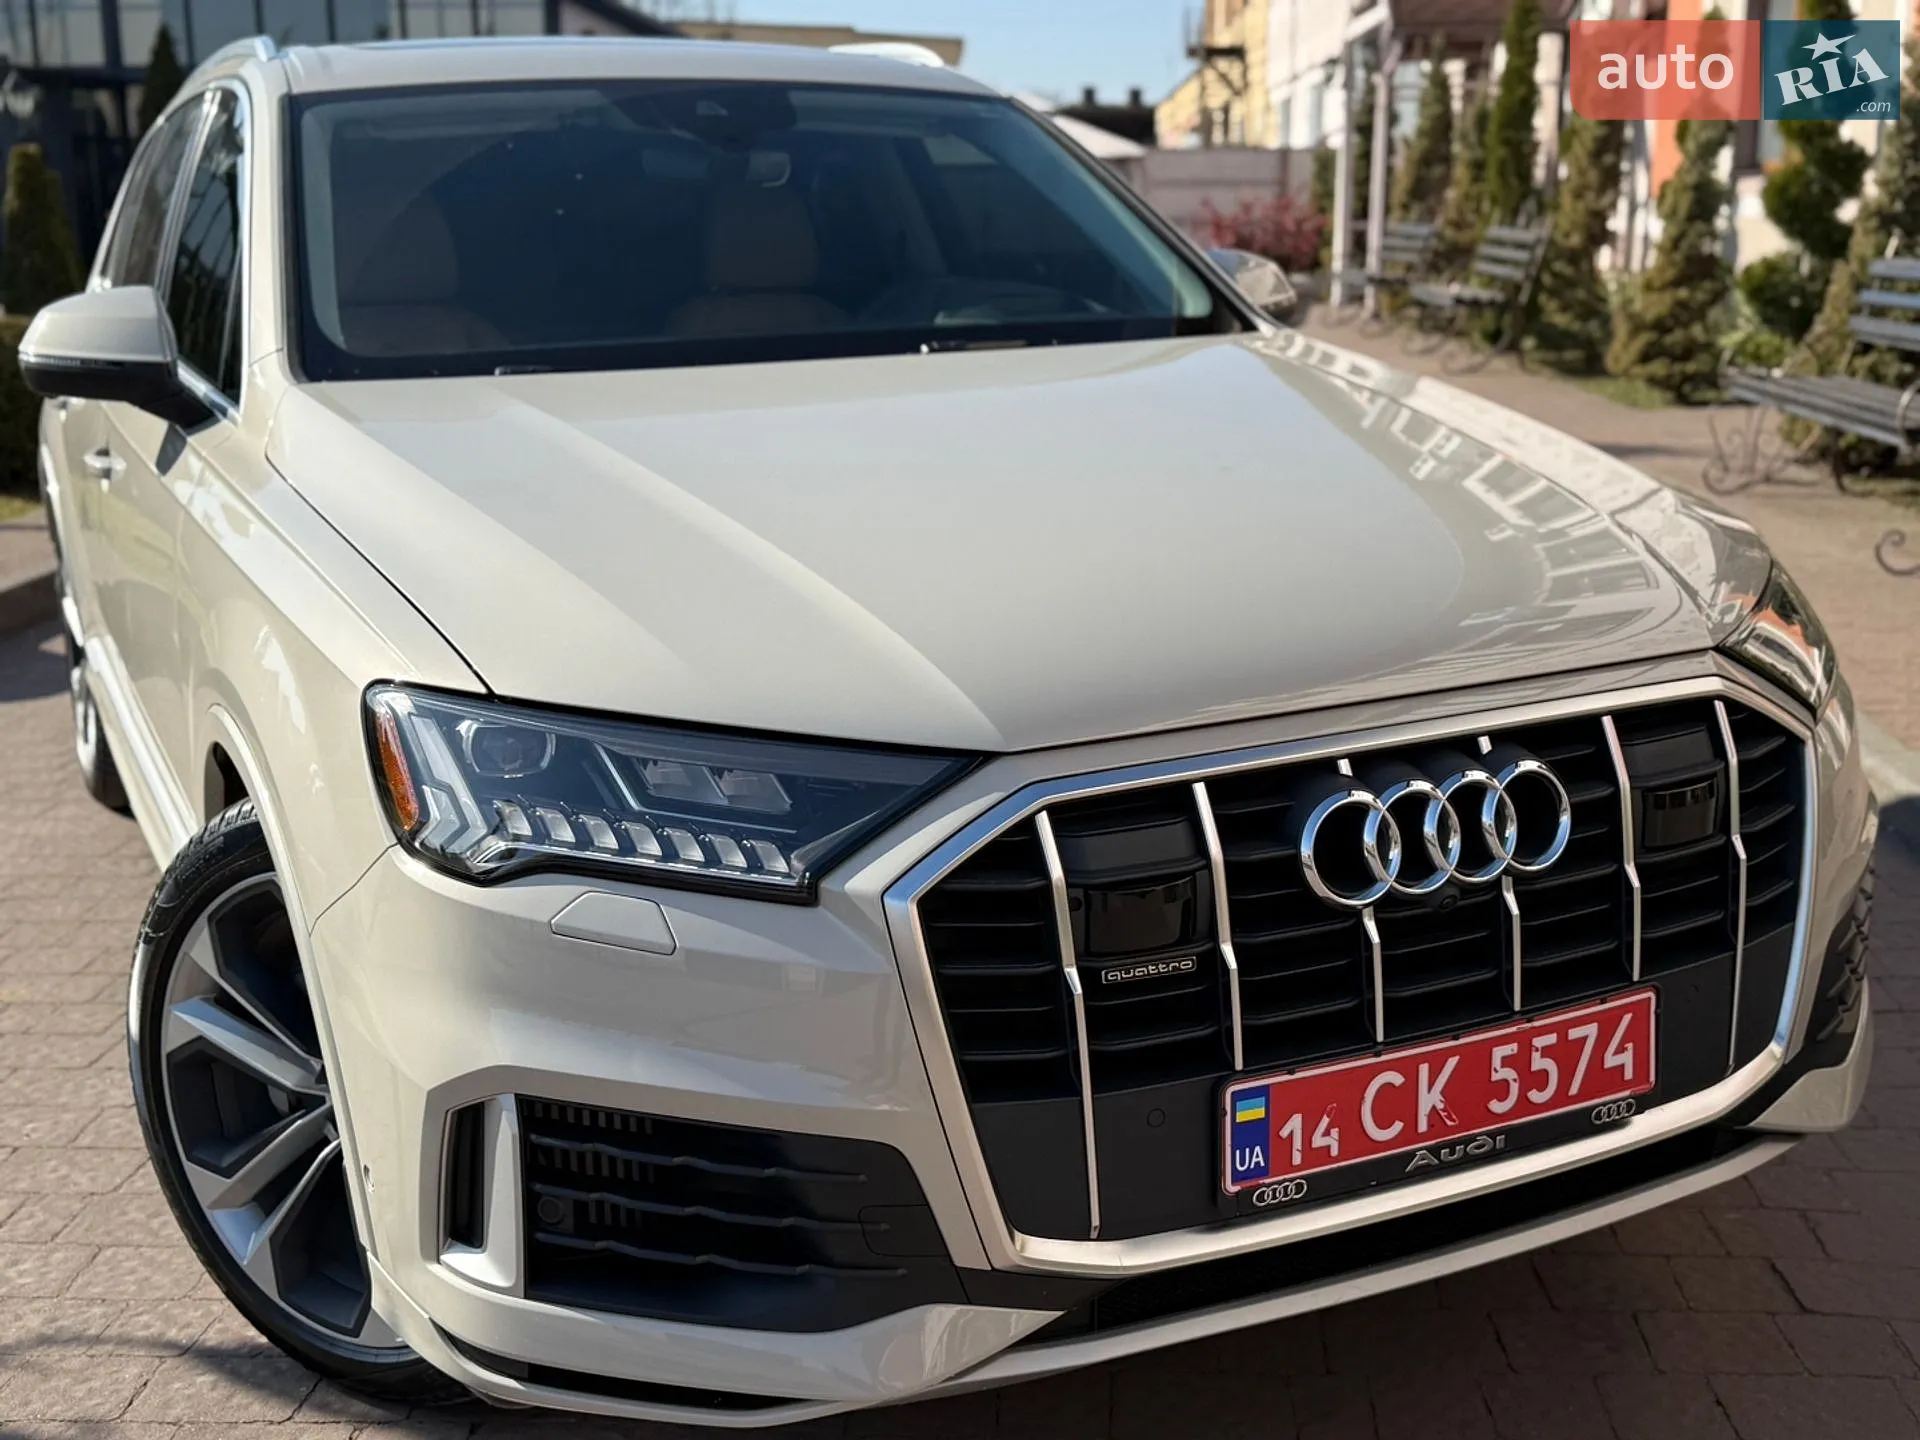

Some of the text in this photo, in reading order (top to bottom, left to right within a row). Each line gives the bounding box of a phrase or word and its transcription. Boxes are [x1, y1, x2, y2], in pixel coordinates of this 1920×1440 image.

[1107, 960, 1193, 981] quattro
[1278, 1012, 1634, 1166] 14 CK 5574
[1235, 1144, 1266, 1173] UA
[1404, 1134, 1506, 1173] Audi
